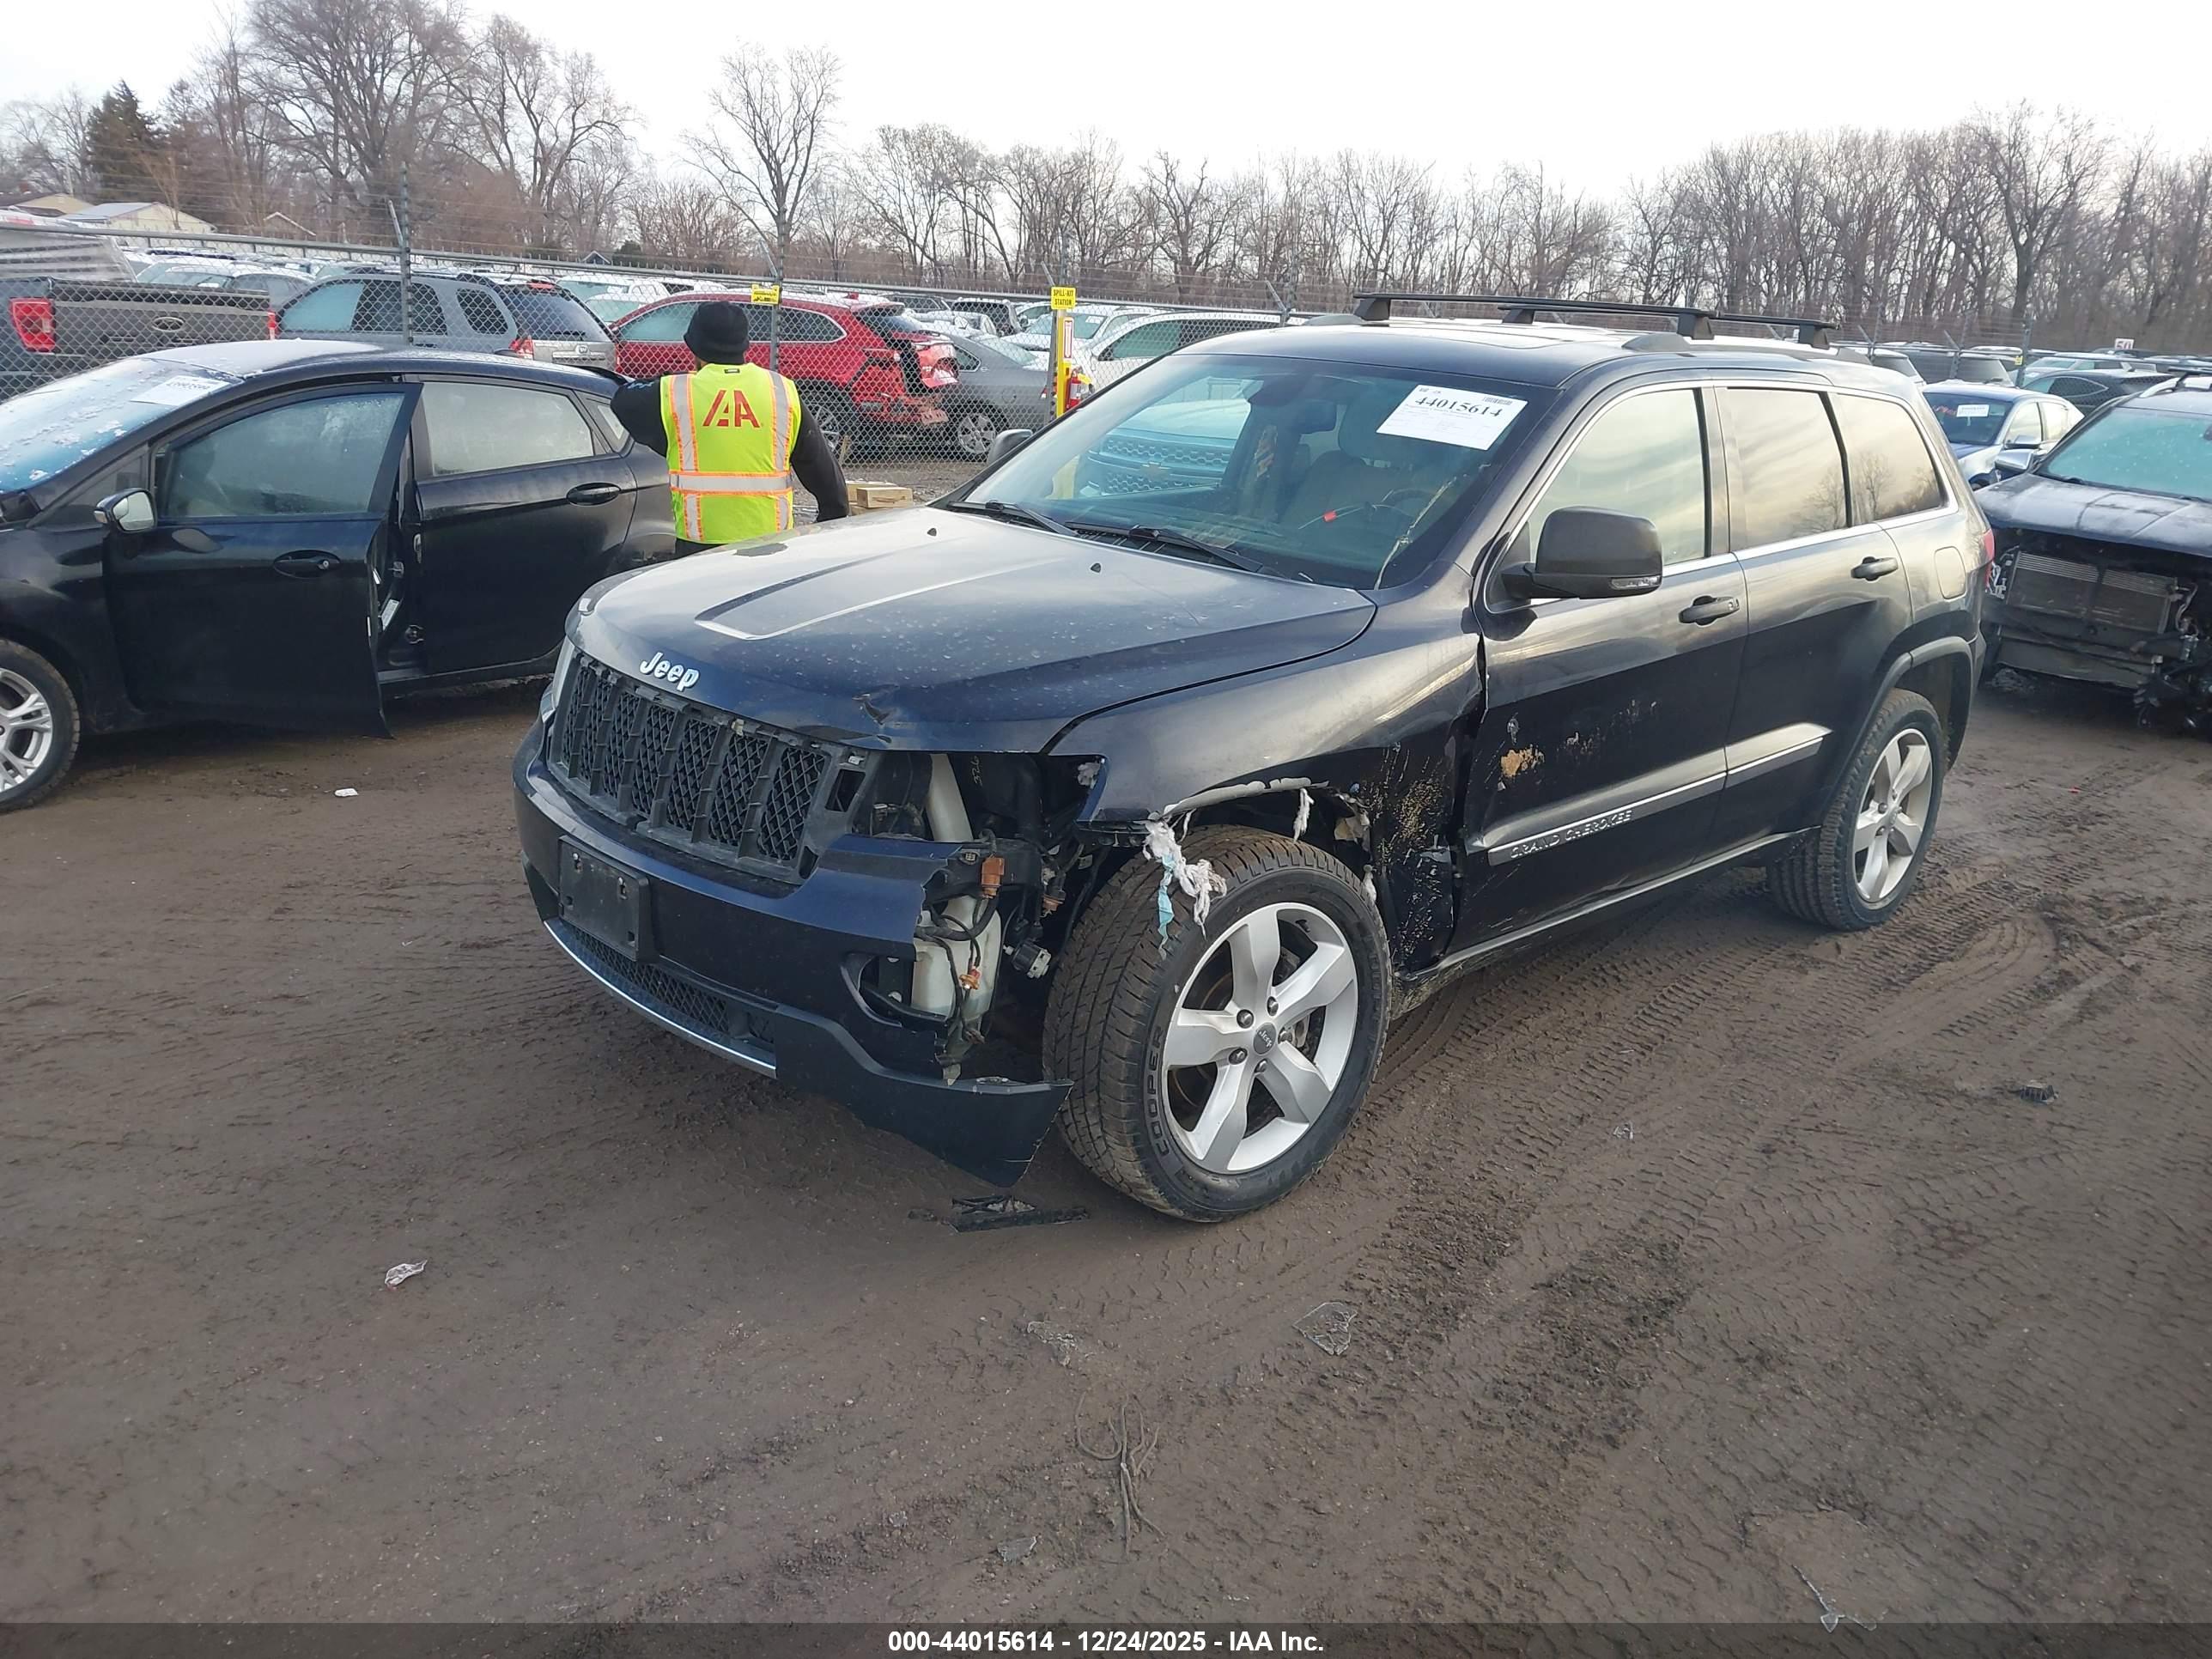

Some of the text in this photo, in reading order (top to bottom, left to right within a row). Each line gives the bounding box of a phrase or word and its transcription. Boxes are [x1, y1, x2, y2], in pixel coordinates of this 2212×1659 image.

[1415, 397, 1503, 416] 44015614
[639, 652, 700, 692] Jeep
[1510, 810, 1632, 859] GRAND CHEROKEE
[1257, 1030, 1273, 1048] Jeep
[1147, 1026, 1170, 1156] COOPER
